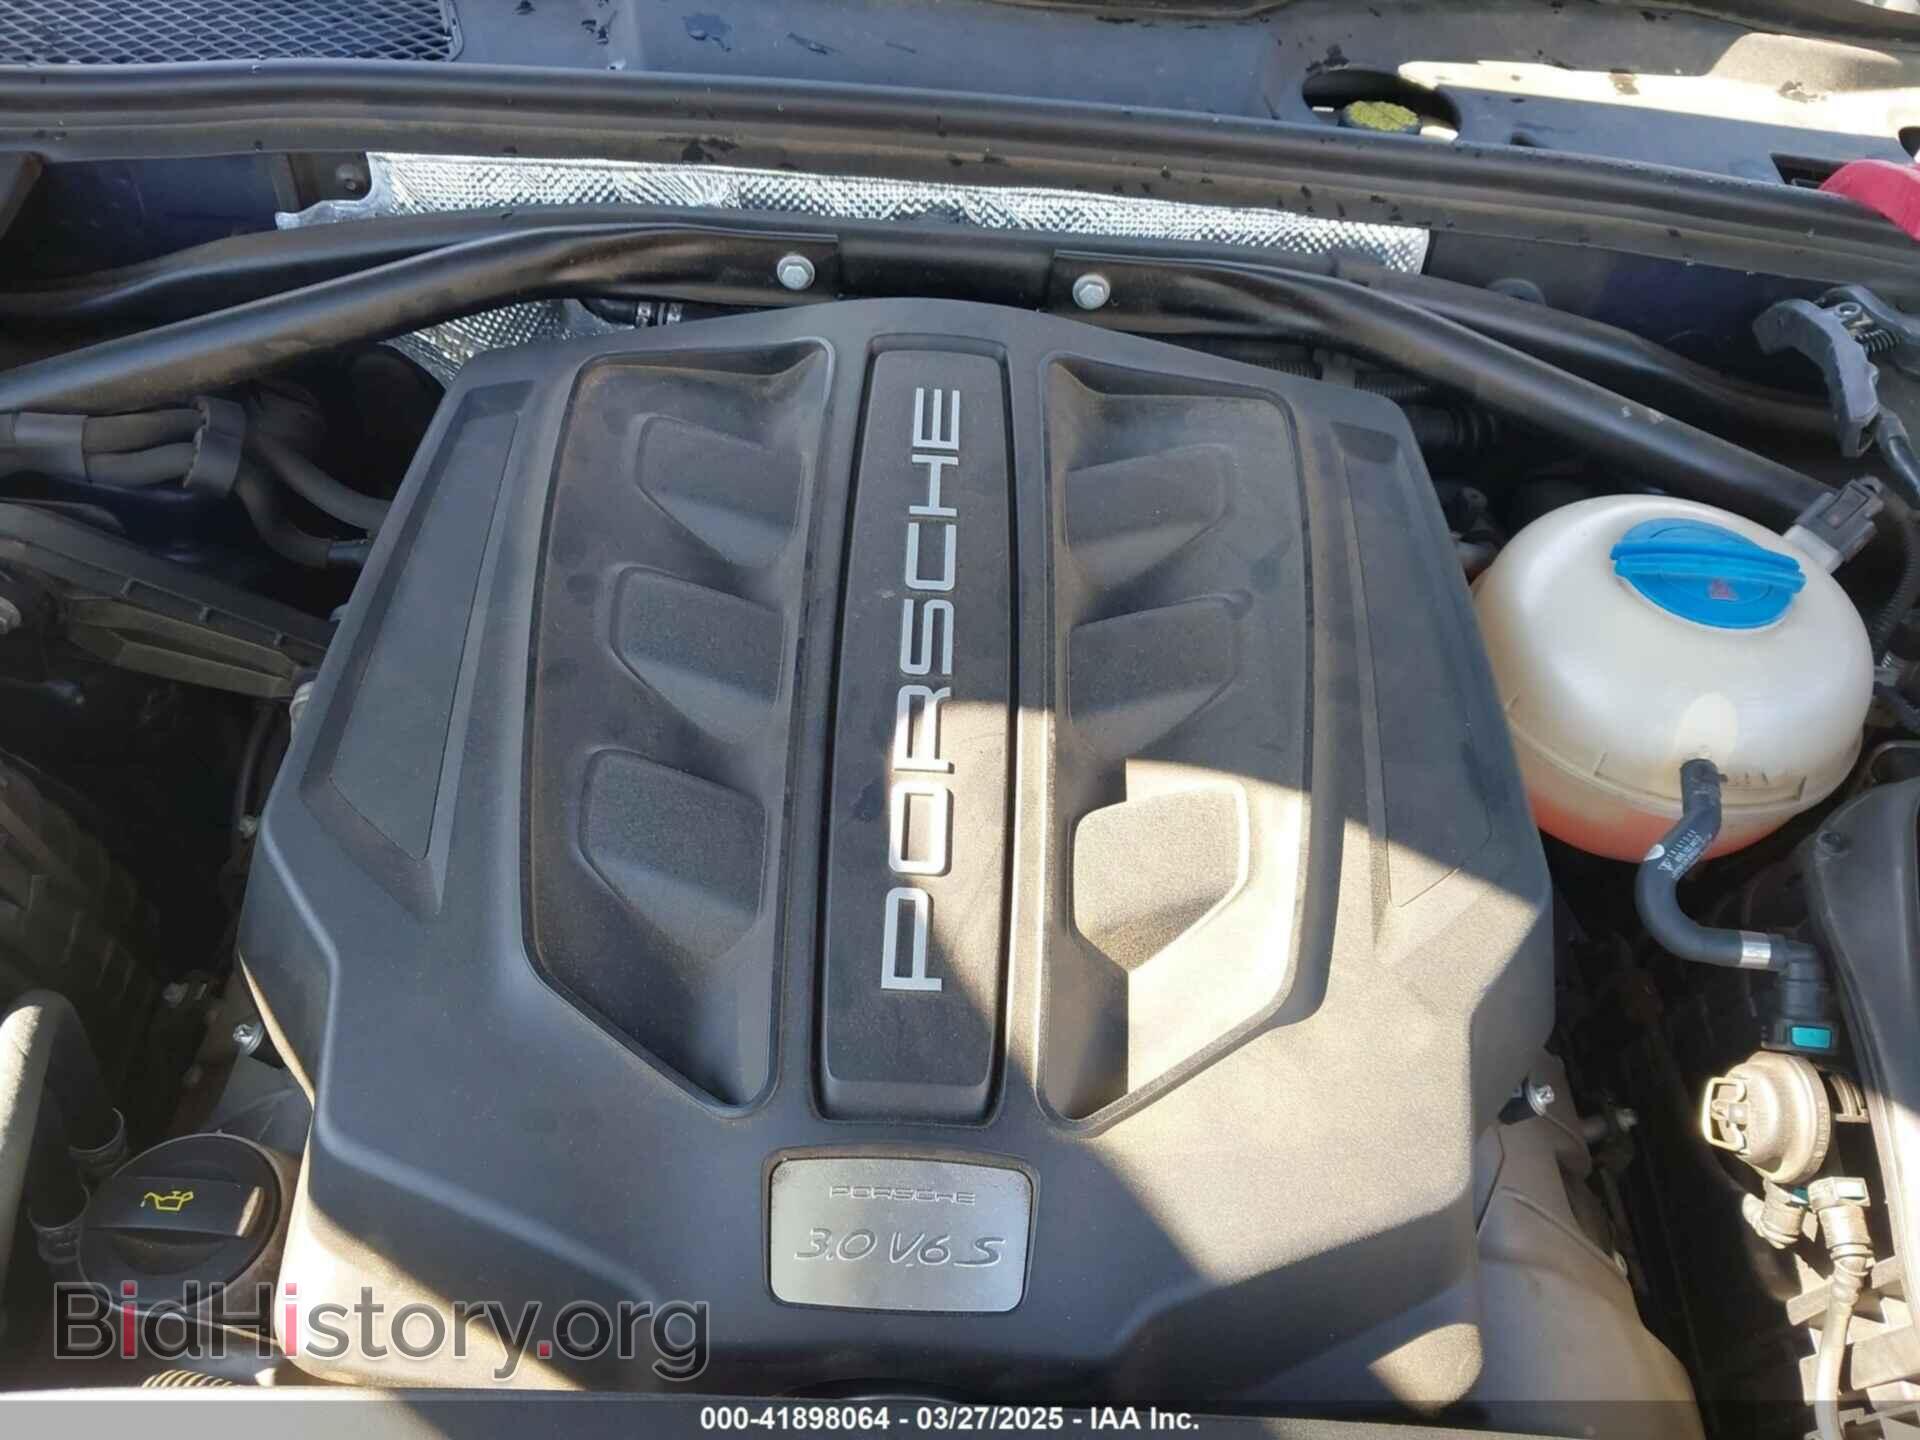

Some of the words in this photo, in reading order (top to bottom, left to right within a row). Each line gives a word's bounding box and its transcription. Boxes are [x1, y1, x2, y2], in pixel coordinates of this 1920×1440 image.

[881, 387, 960, 992] PORSCHE
[829, 1185, 976, 1206] PORSCHE
[794, 1227, 878, 1262] 3.0
[953, 1236, 1006, 1268] S
